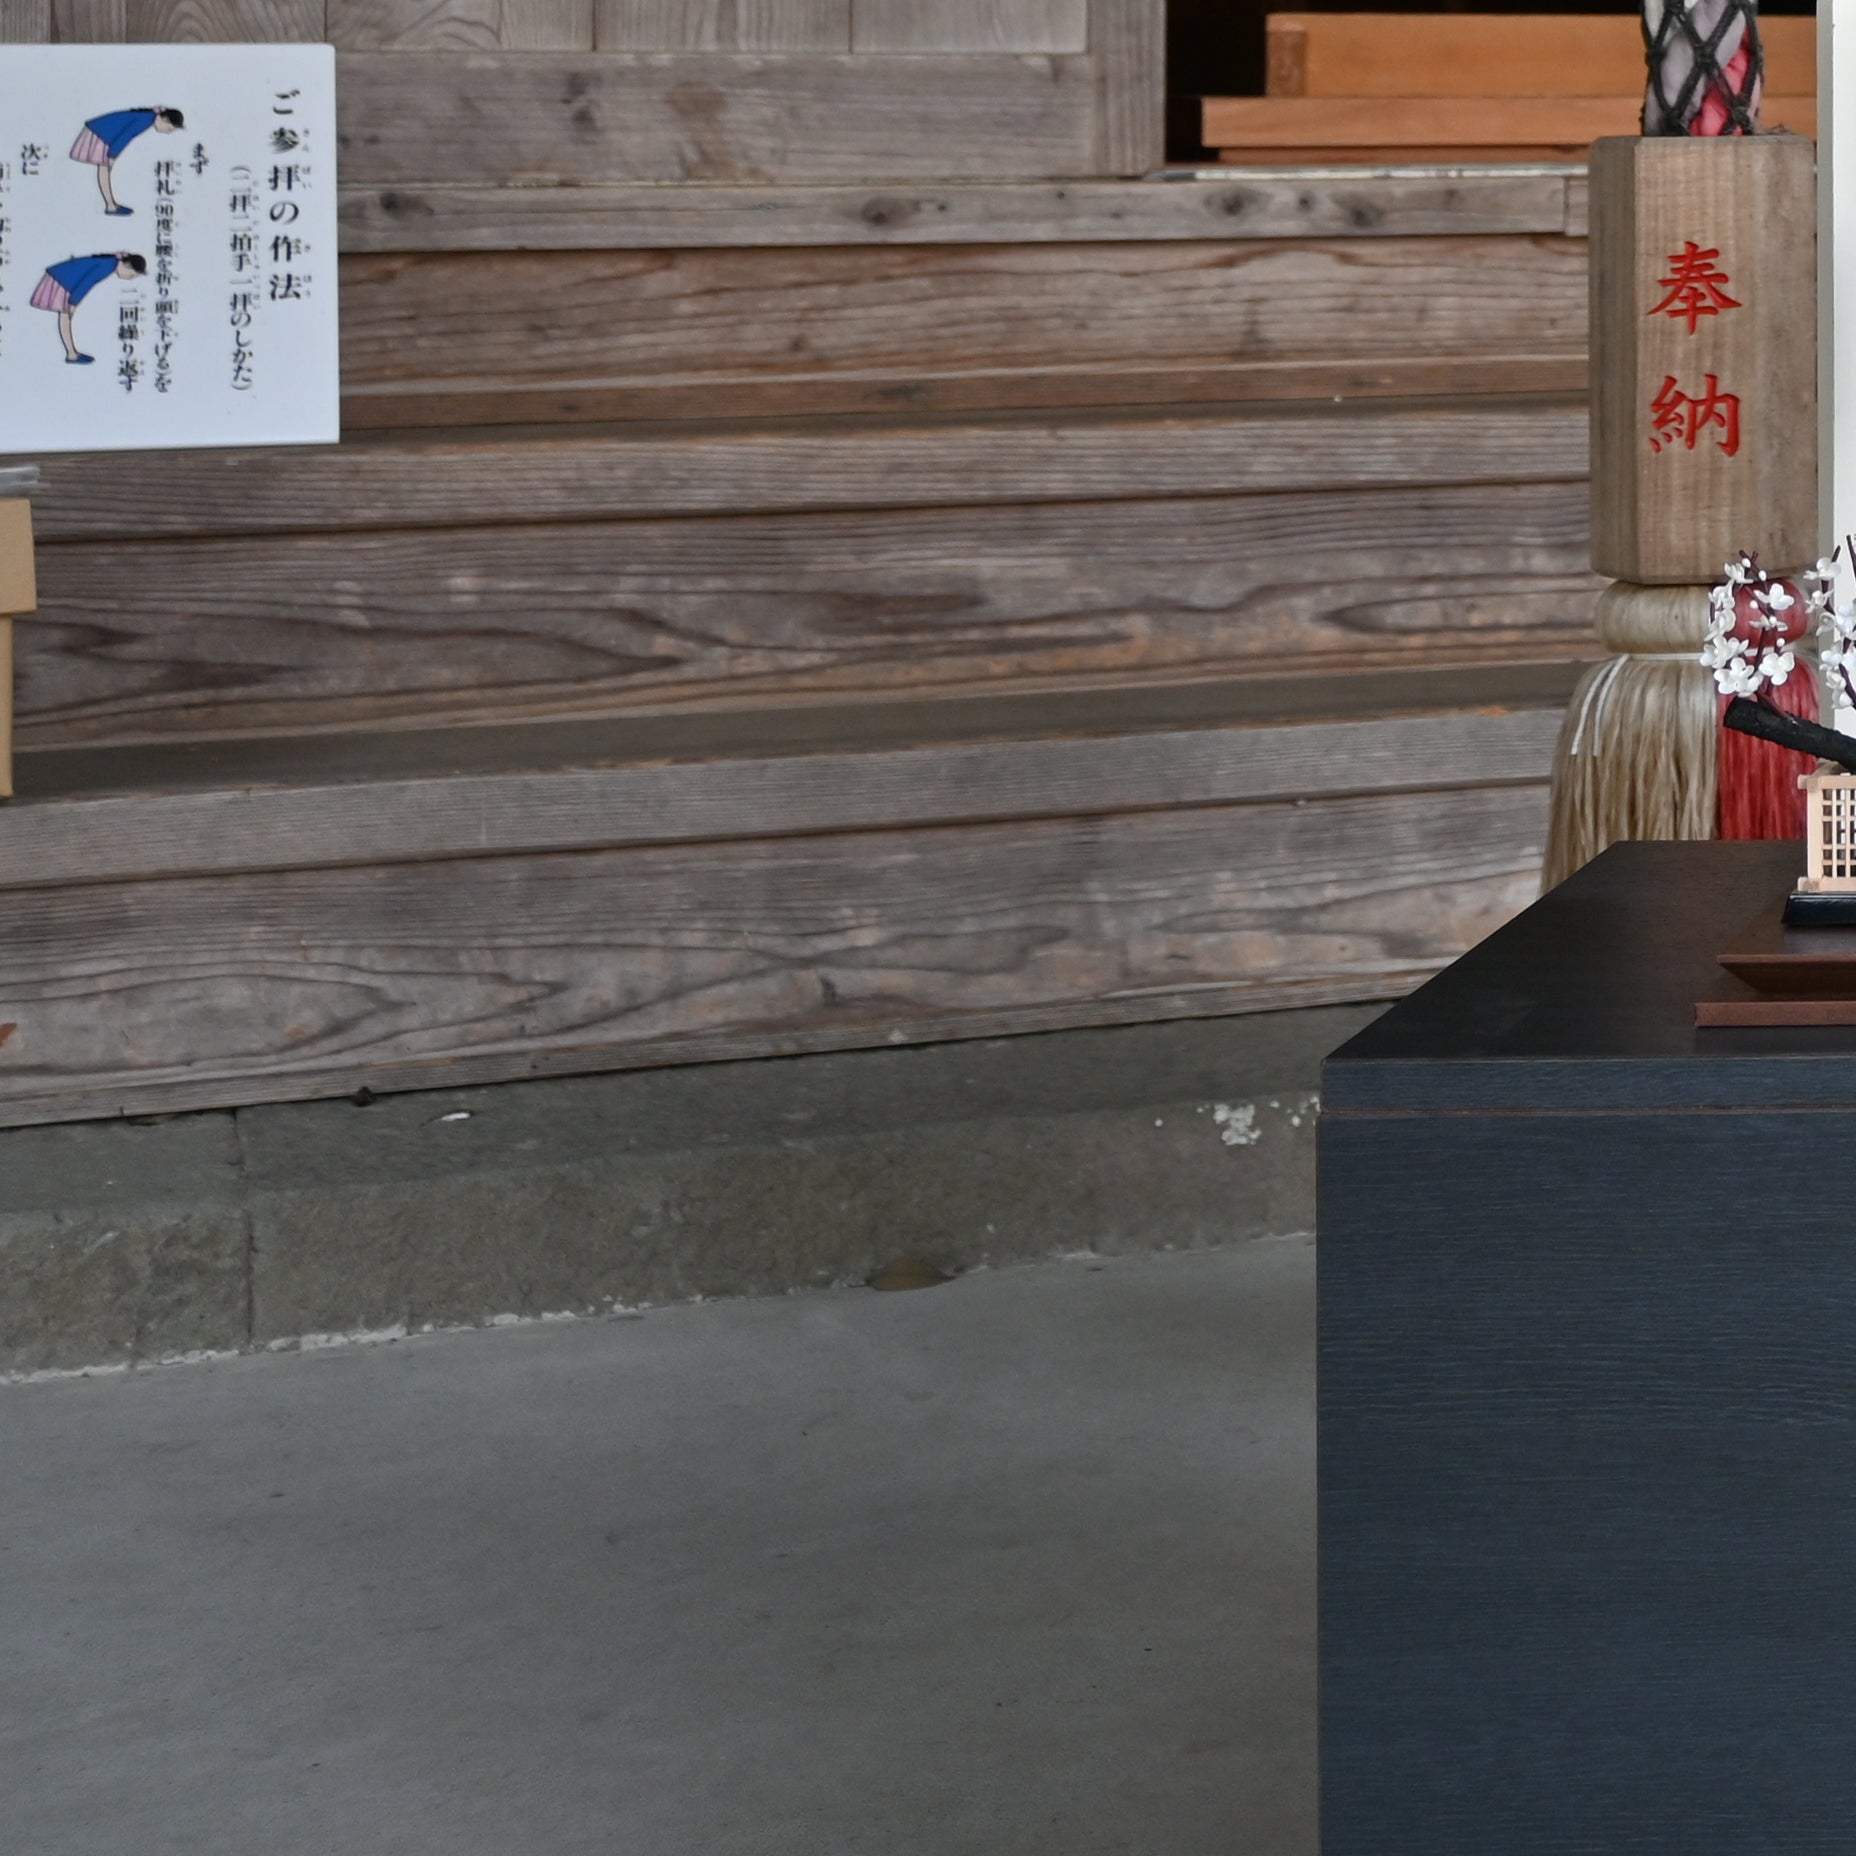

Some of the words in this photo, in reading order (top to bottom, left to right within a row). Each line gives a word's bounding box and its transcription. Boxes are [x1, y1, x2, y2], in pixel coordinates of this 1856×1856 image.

[21, 143, 41, 176] 次に
[190, 143, 209, 175] まず
[268, 89, 301, 301] ご参拝の作法
[118, 288, 139, 394] 二回繰り返す
[1646, 240, 1743, 457] 奉納
